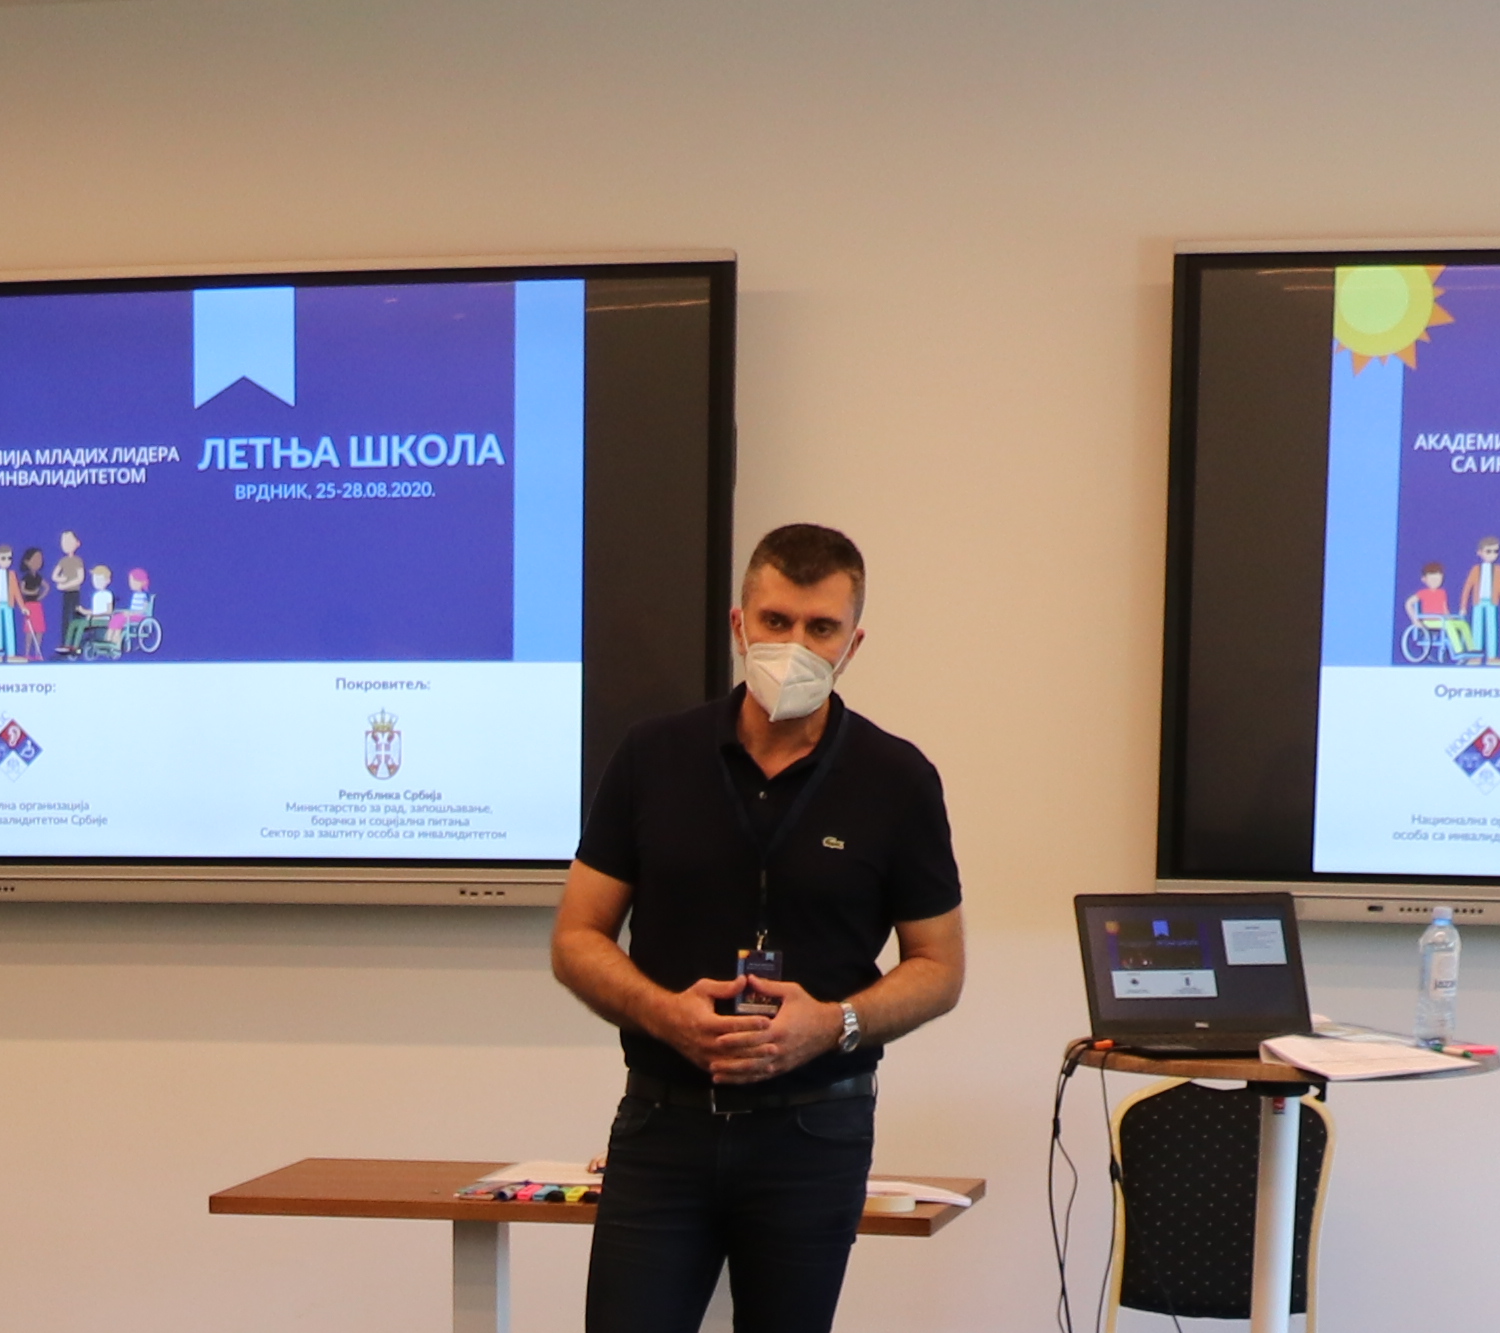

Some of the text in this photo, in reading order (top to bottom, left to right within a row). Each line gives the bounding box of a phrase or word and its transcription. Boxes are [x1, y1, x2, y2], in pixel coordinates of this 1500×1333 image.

[35, 447, 109, 467] МЛАДИХ
[110, 446, 180, 466] ЛИДЕРА
[197, 433, 506, 471] ЛЕТЊА ШКОЛА
[1451, 455, 1477, 473] СА
[234, 481, 436, 502] ВРДНИК, 25-28.08.2020.
[335, 677, 431, 693] Покровитељ:
[338, 789, 442, 803] Република Србија
[19, 800, 90, 814] организација
[285, 802, 367, 815] Министарство
[369, 804, 382, 814] за
[71, 813, 108, 827] Србије
[311, 815, 470, 829] борачка и социјална питања
[1411, 814, 1488, 827] Национална
[260, 827, 507, 841] Сектор за заштиту особа са инвалидитетом
[1392, 829, 1429, 841] особа
[1432, 832, 1446, 841] са
